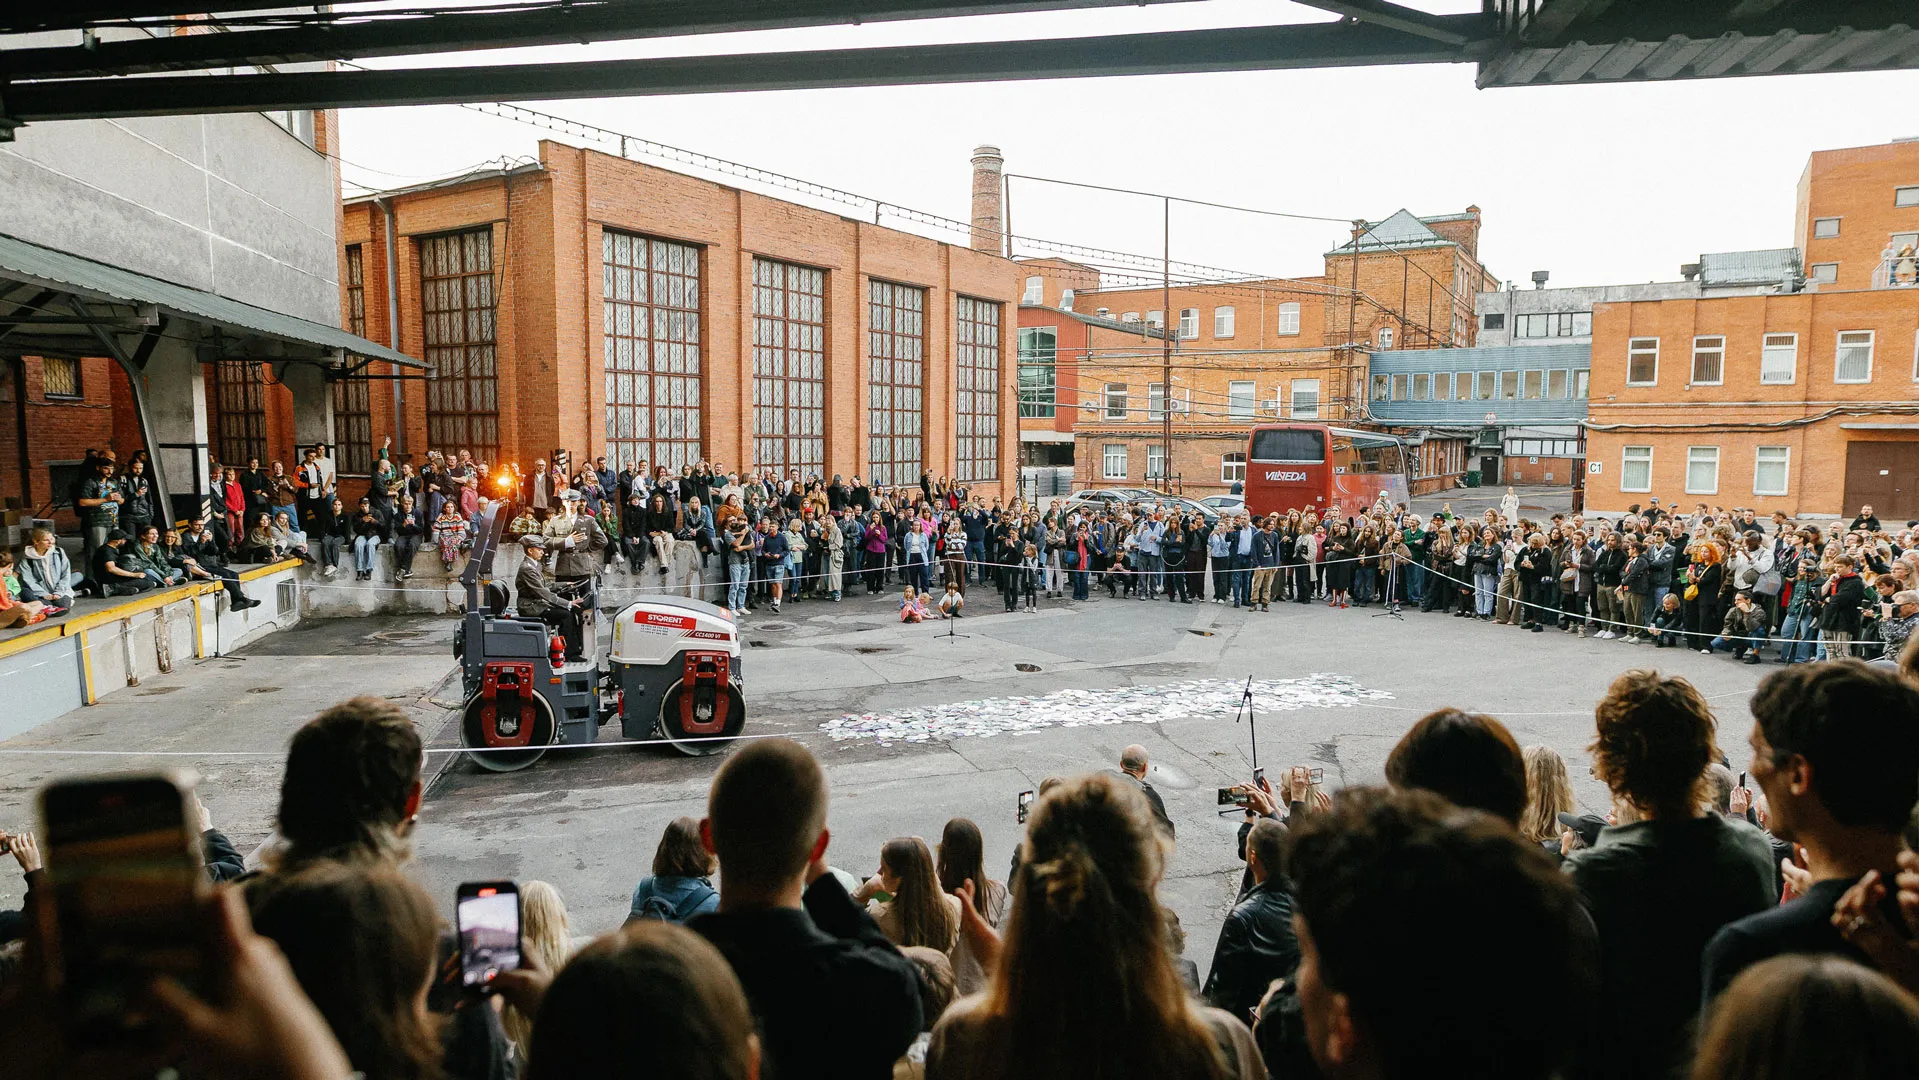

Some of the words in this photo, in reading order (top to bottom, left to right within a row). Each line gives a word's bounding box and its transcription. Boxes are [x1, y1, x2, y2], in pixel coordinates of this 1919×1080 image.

[1590, 463, 1601, 473] C1
[648, 614, 683, 624] STORENT
[695, 631, 715, 639] CC1400
